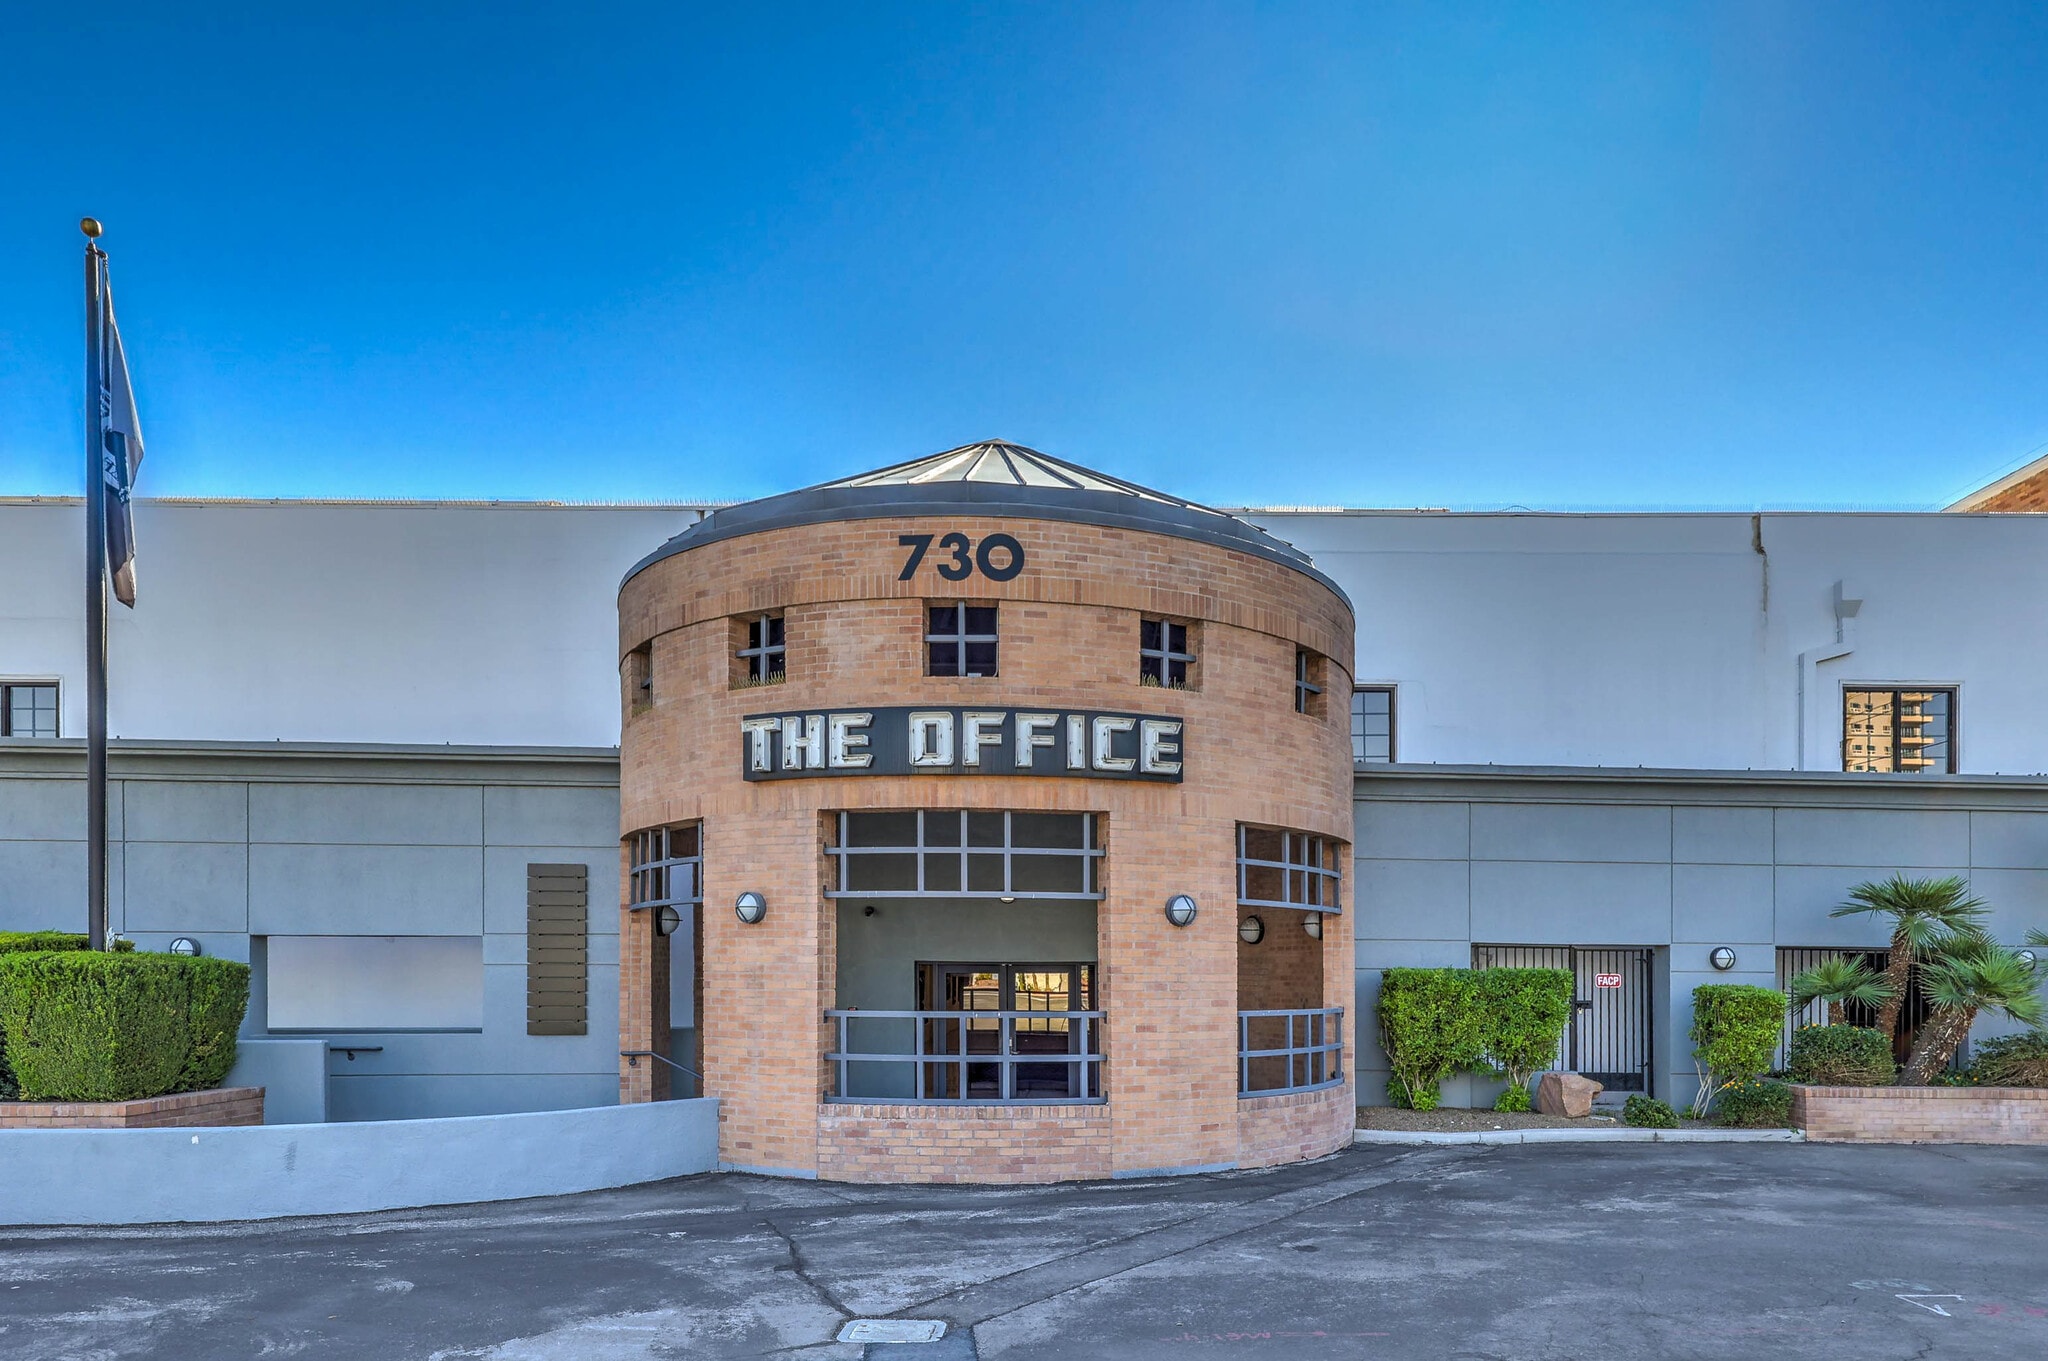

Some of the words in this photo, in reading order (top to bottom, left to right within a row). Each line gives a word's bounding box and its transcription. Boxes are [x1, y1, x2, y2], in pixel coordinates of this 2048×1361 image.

[898, 533, 1025, 581] 730
[742, 712, 873, 772] THE
[908, 711, 1183, 774] OFFICE
[1597, 976, 1619, 986] FACP
